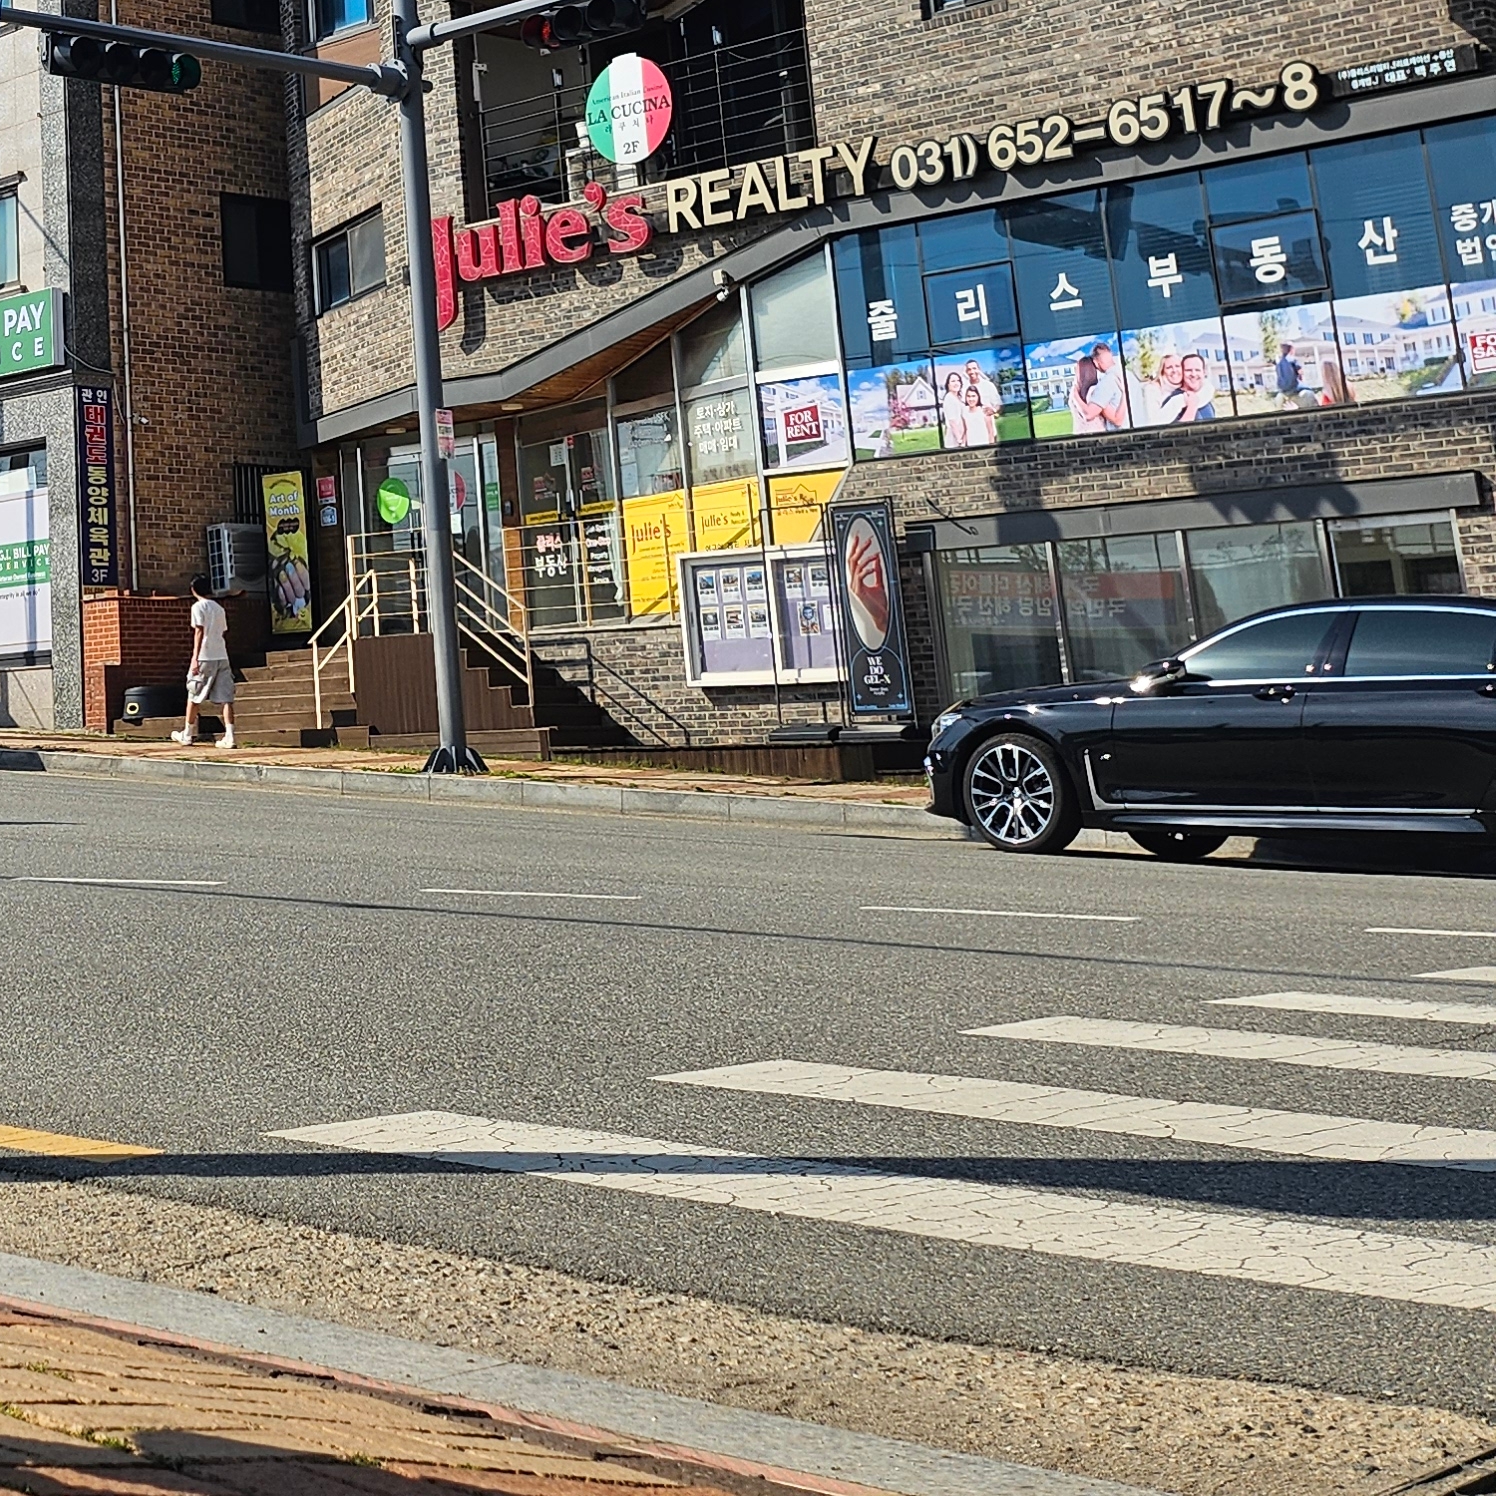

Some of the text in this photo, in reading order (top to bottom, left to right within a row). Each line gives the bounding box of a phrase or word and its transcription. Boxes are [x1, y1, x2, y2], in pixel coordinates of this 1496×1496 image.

[621, 90, 641, 98] Italian
[587, 95, 670, 126] LA CUCINA
[624, 141, 640, 155] 2F
[430, 61, 1318, 332] Julie's REALTY 031) 652-6517~8
[4, 301, 45, 337] PAY
[789, 410, 813, 426] FOR
[786, 421, 819, 439] RENT
[84, 405, 111, 566] 태권도 동양체육관
[269, 490, 299, 504] Art of
[269, 504, 300, 516] Month
[701, 513, 729, 535] Julie's
[631, 518, 672, 555] Julie's
[13, 547, 31, 559] BILL
[33, 543, 50, 556] PAY
[535, 554, 567, 578] 부동산
[91, 569, 107, 583] 3F
[867, 656, 883, 666] WE
[869, 666, 884, 675] DO
[863, 674, 891, 684] GEL-X
